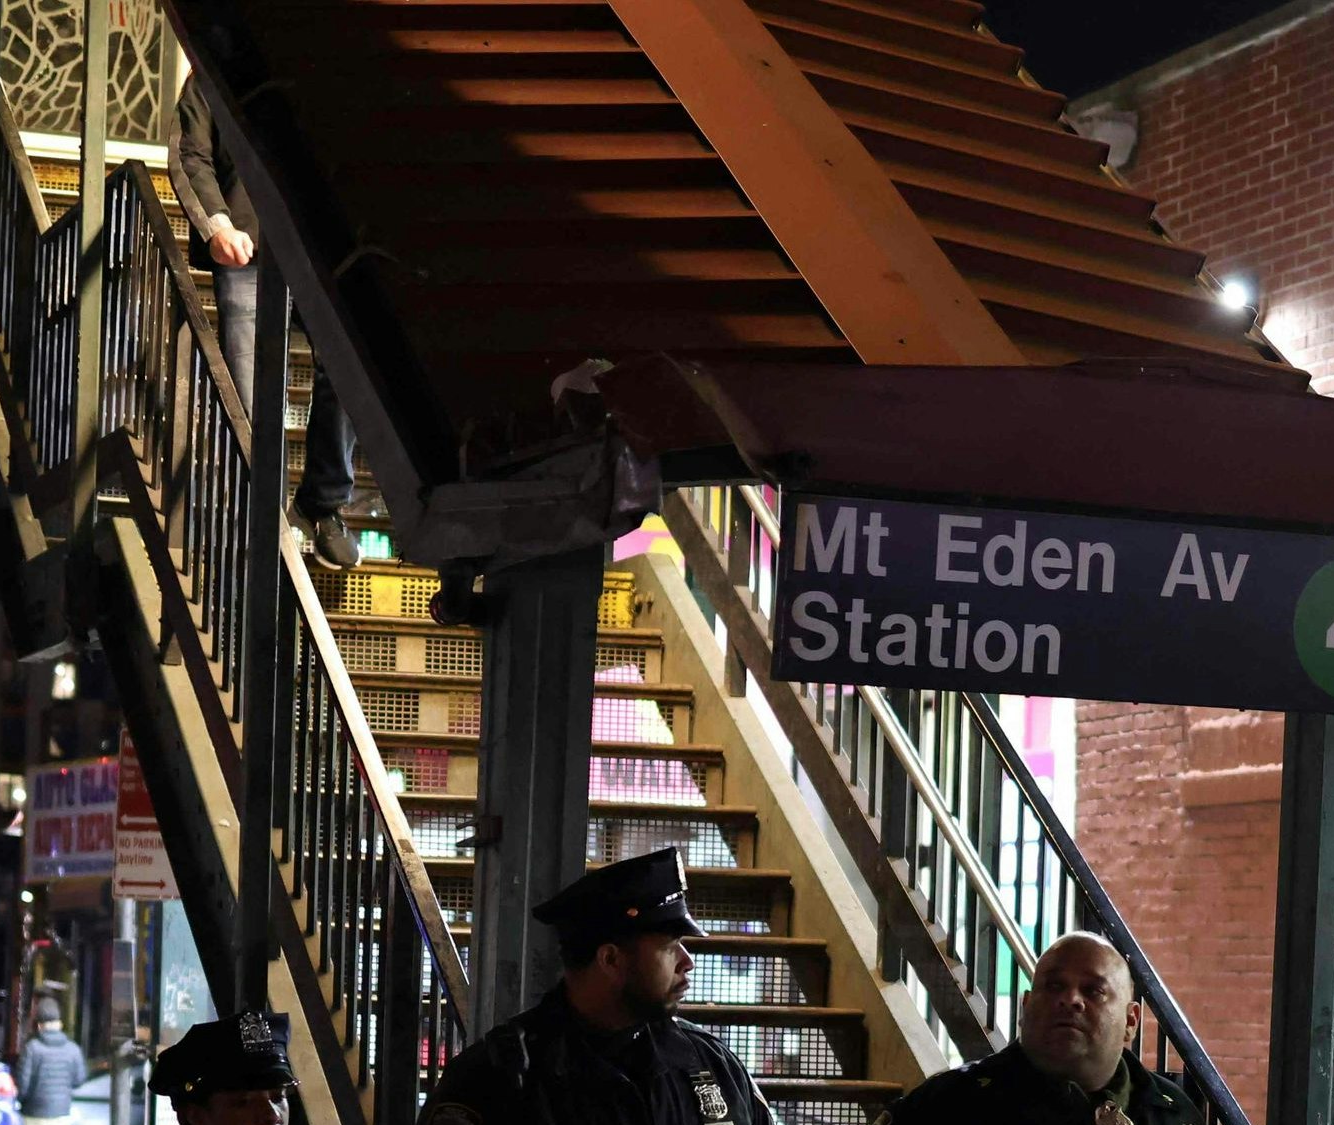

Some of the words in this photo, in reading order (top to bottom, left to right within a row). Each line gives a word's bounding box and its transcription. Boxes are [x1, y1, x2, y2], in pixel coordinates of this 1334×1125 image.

[795, 503, 888, 578] Mt
[935, 513, 1116, 594] Eden
[1160, 533, 1251, 602] Av
[789, 590, 1062, 675] Station
[119, 854, 153, 866] Anytime
[120, 838, 131, 848] NO
[133, 837, 164, 850] PARKIN
